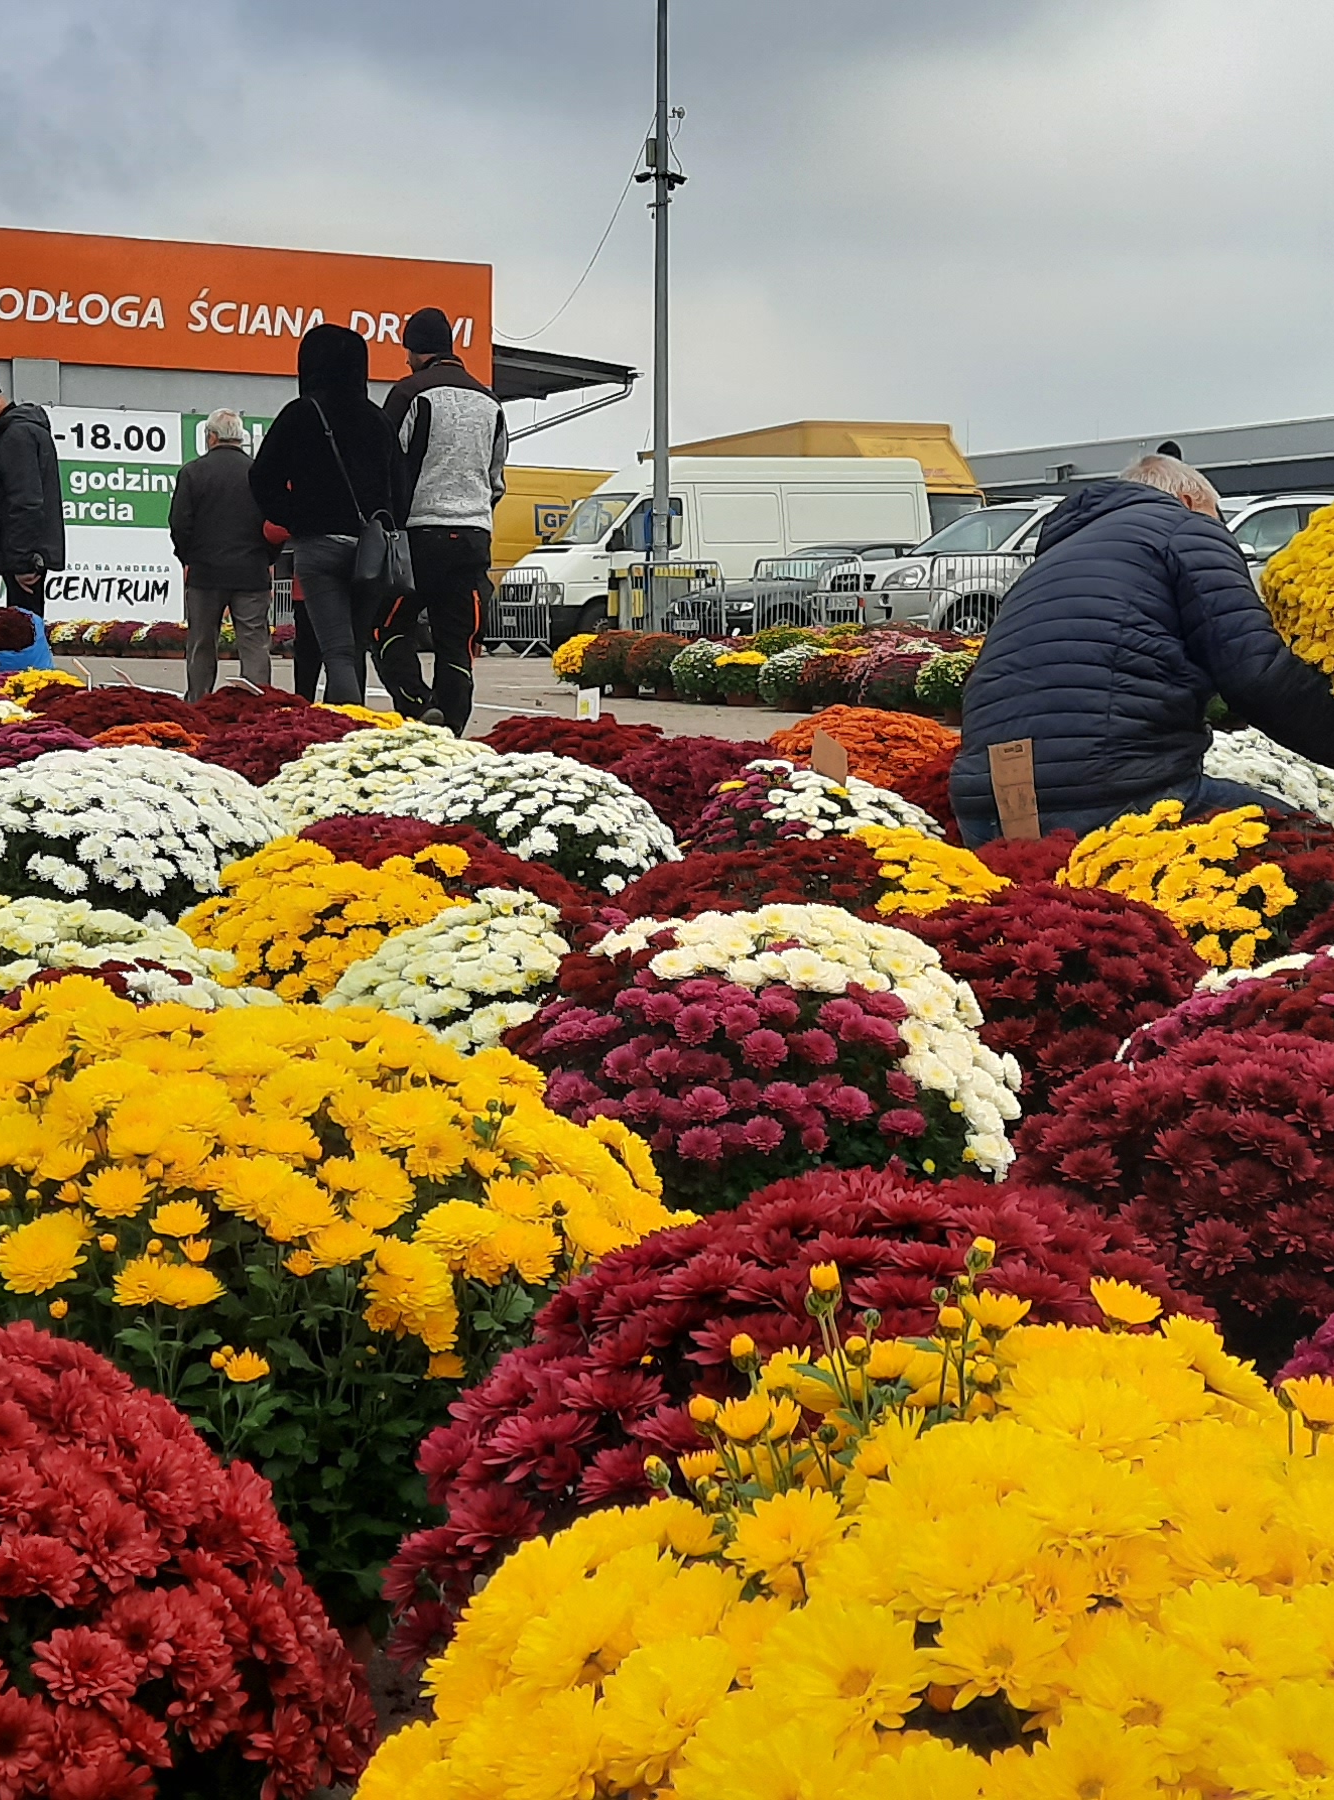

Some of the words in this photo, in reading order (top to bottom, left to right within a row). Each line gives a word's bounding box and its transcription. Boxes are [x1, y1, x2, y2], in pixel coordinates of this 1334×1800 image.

[187, 287, 325, 338] ŚCIANA
[349, 310, 474, 348] DRI
[45, 575, 170, 607] CENTRUM
